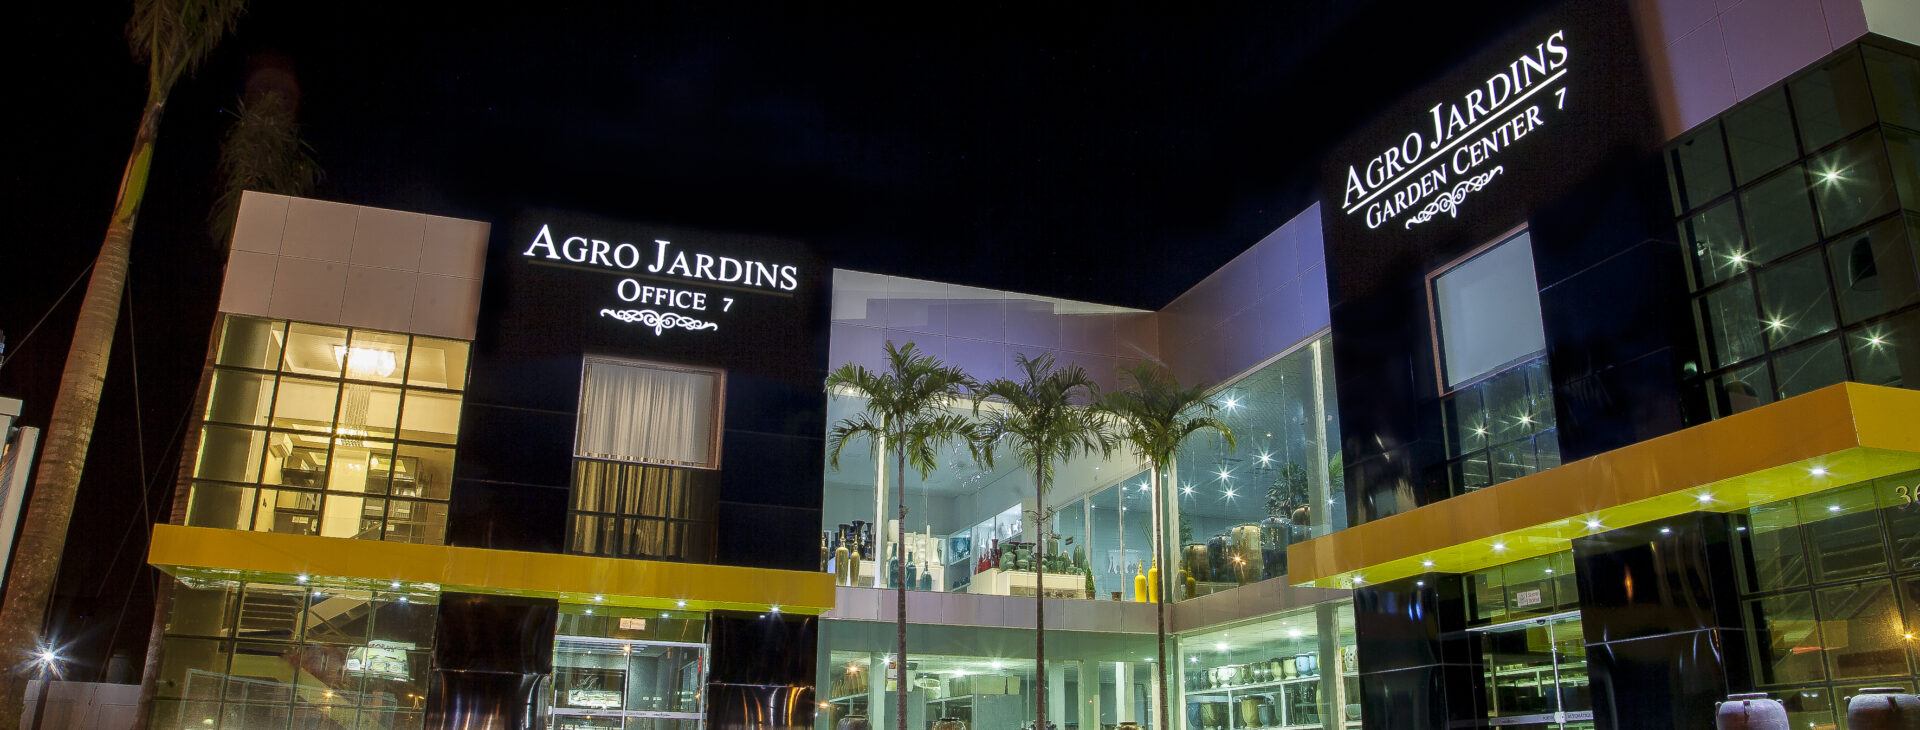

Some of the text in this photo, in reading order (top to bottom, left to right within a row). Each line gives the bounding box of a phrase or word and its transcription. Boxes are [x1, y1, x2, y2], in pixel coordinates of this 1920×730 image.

[1342, 29, 1568, 209] AGRO JARDINS
[1366, 86, 1567, 229] GARDEN CENTER 7
[523, 224, 798, 291] AGRO JARDINS
[617, 278, 734, 313] OFFICE 7
